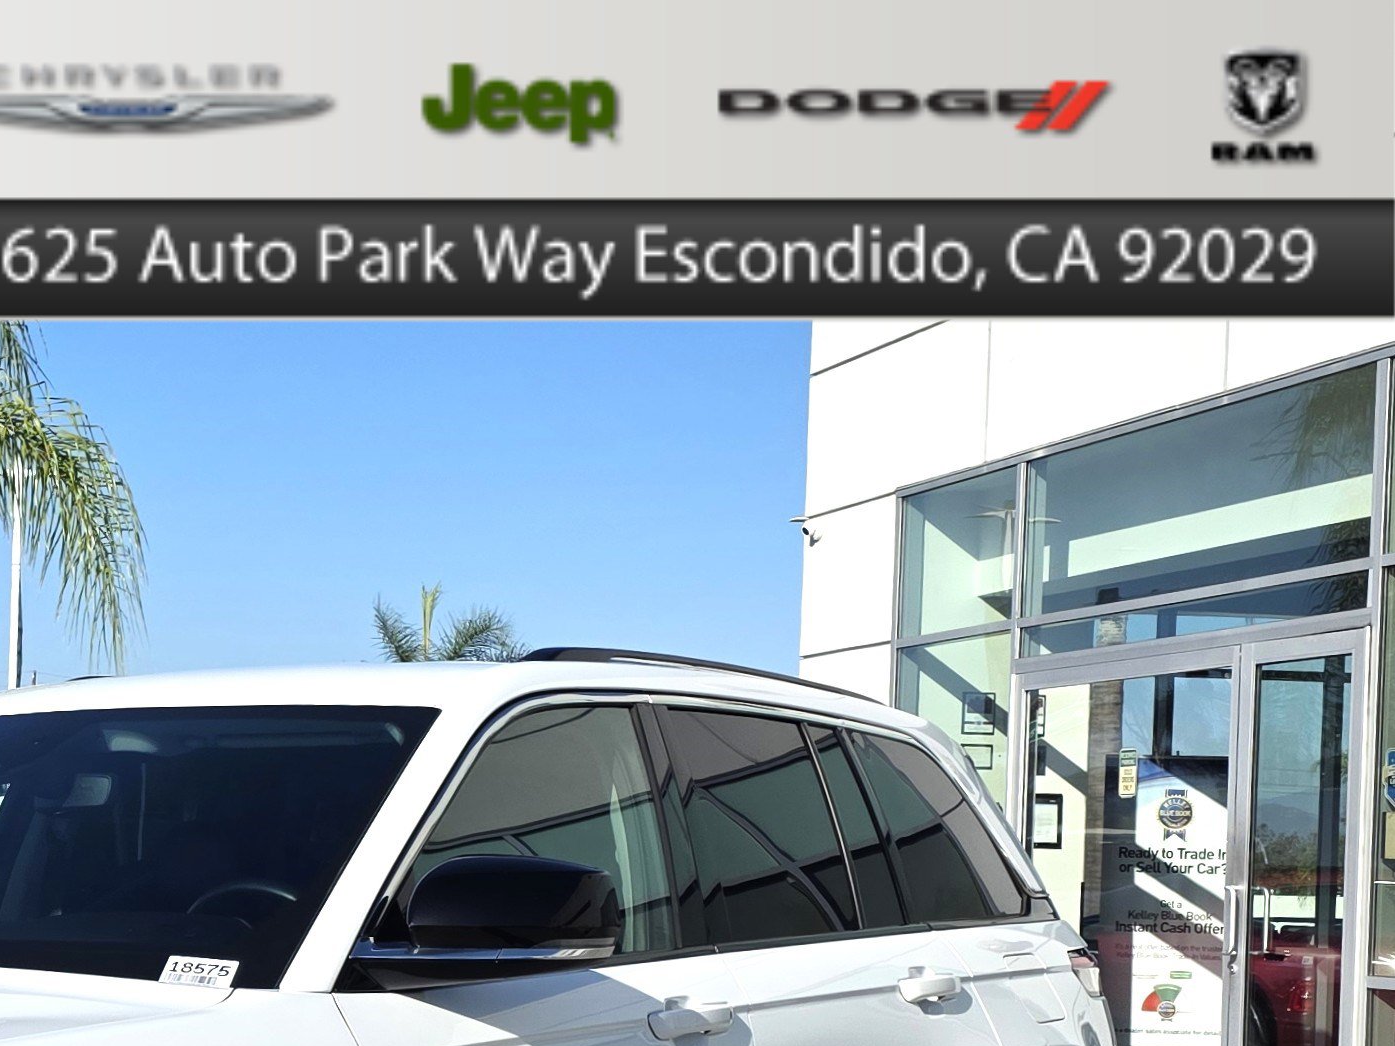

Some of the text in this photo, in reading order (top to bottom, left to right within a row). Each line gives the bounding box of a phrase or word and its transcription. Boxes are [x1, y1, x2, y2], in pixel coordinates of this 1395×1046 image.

[1118, 847, 1159, 862] Ready
[1162, 848, 1174, 859] to
[1177, 848, 1214, 860] Trade
[1119, 863, 1133, 872] or
[1135, 862, 1161, 873] Sell
[1164, 862, 1194, 874] Your
[1160, 900, 1174, 909] Get
[1127, 910, 1213, 921] Kelley Blue Book
[1115, 921, 1224, 935] Instant Cash Offer
[169, 961, 232, 977] 18575
